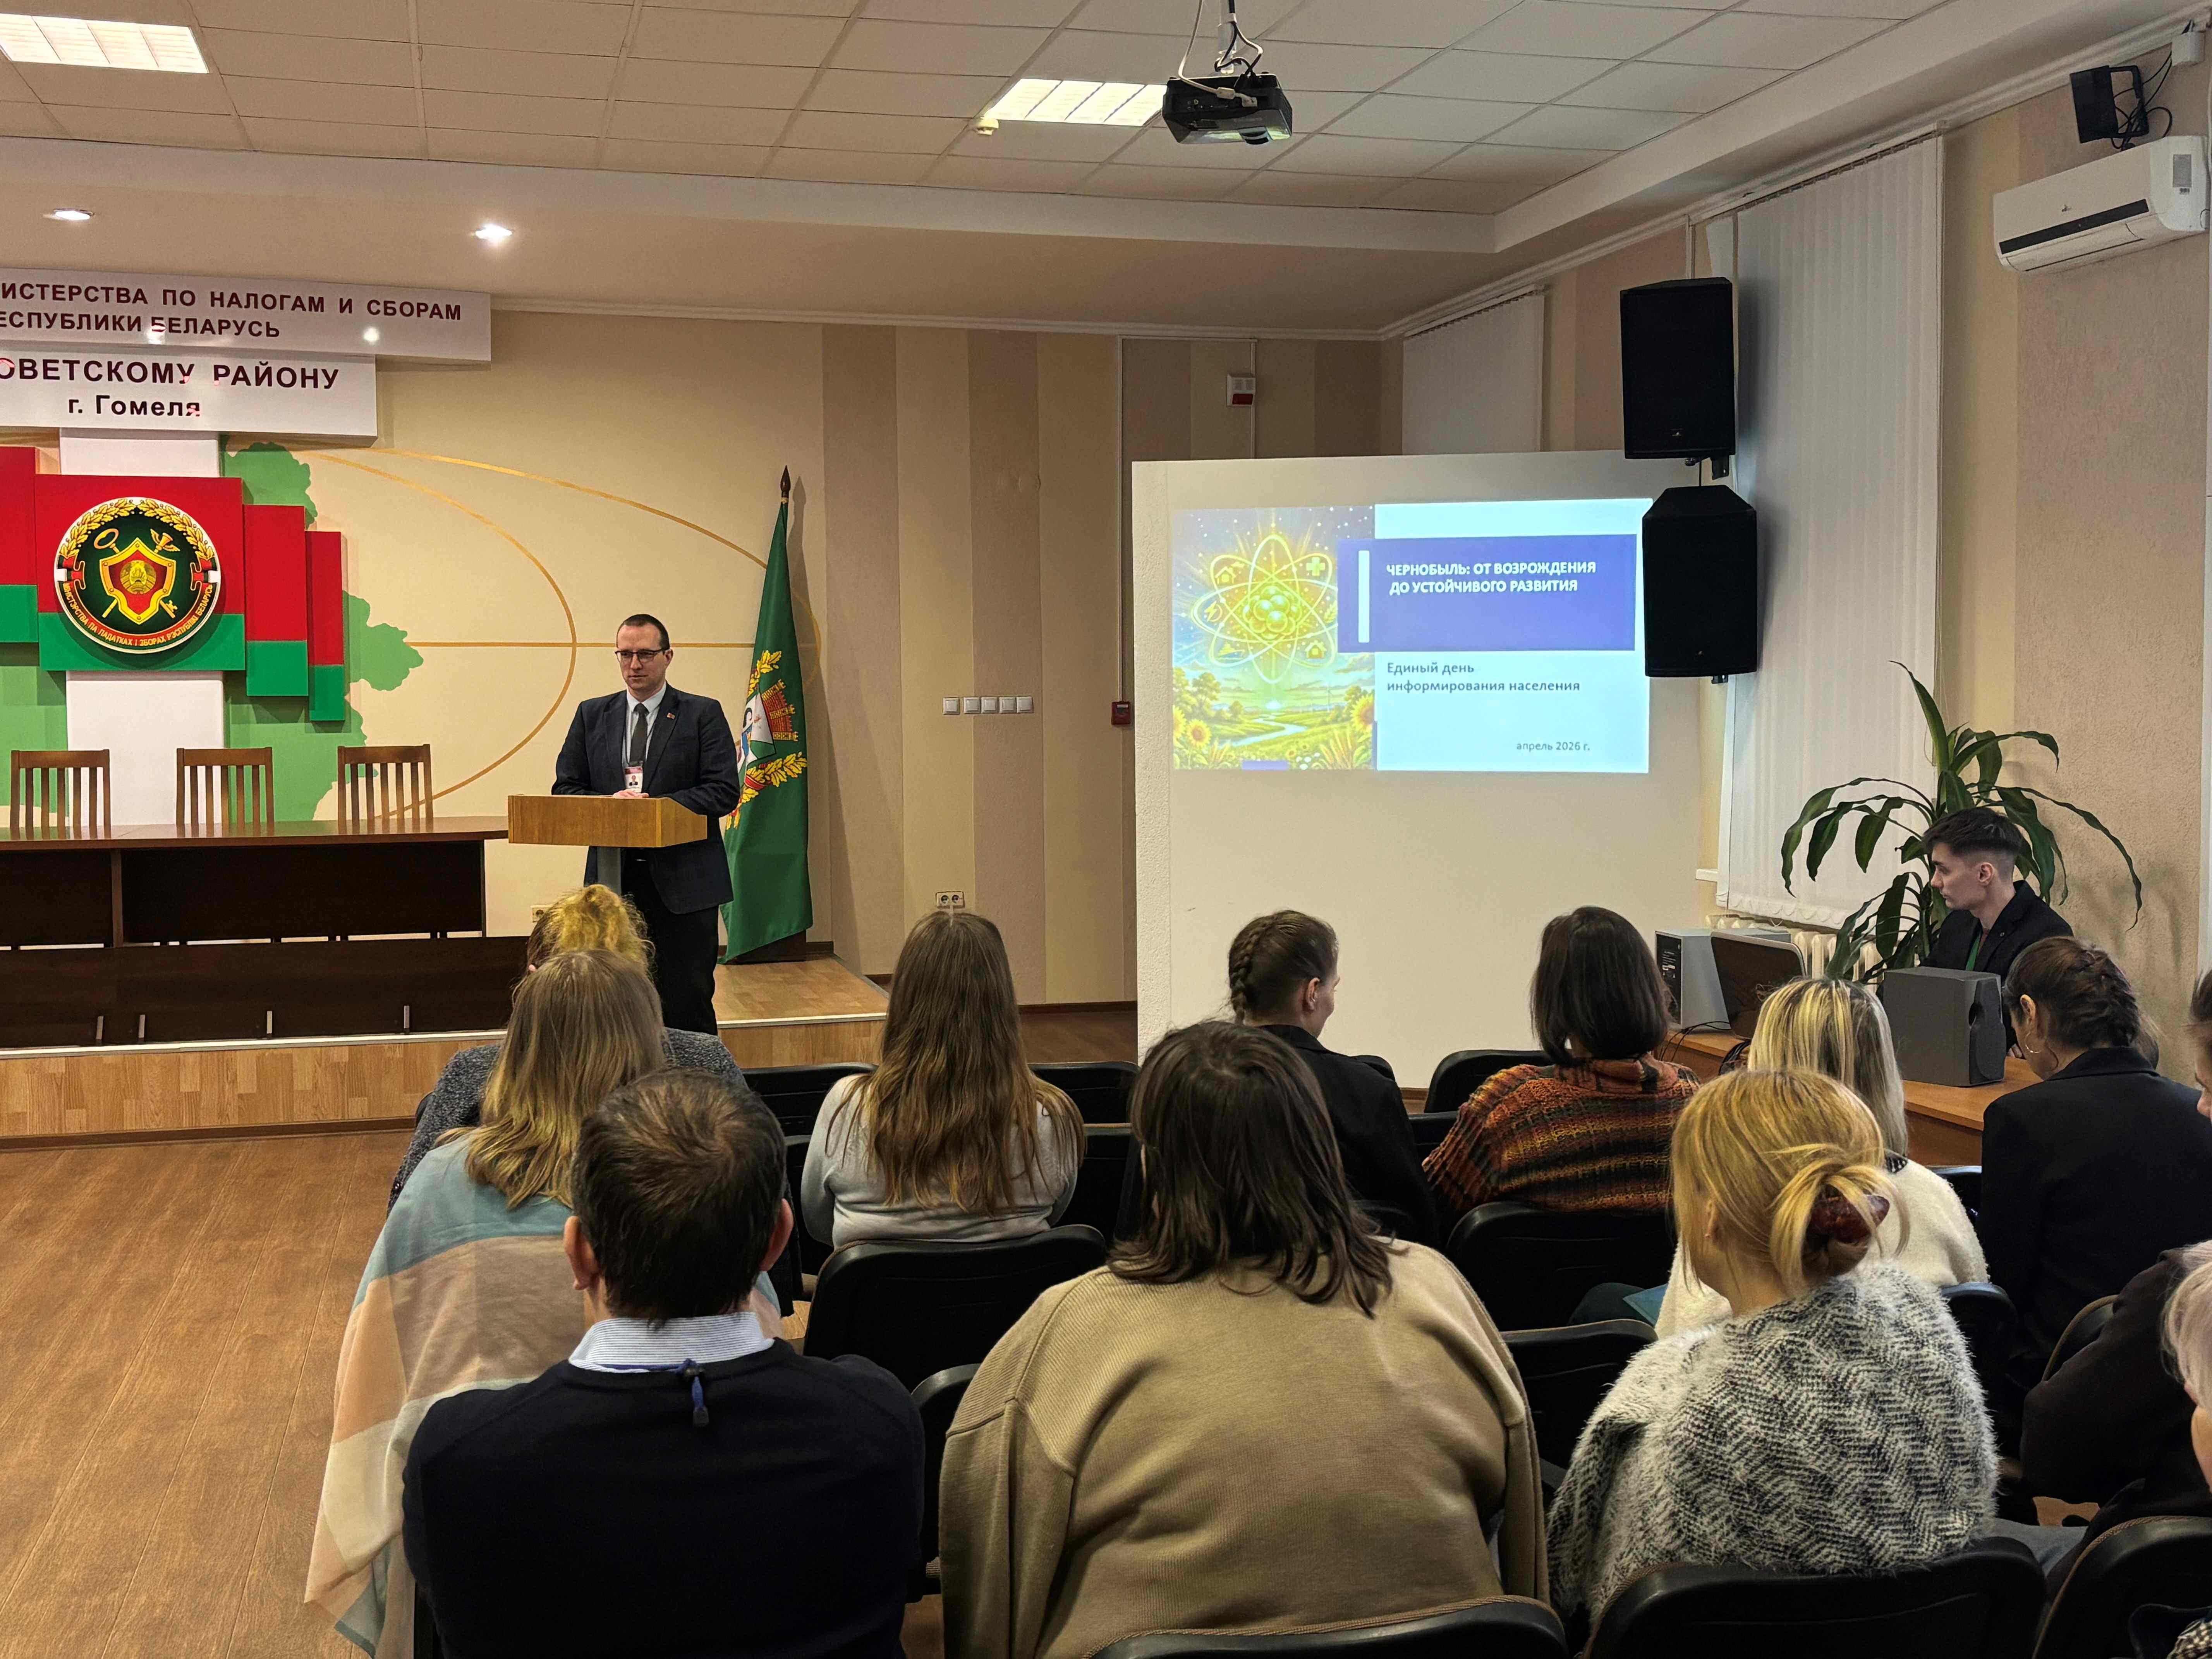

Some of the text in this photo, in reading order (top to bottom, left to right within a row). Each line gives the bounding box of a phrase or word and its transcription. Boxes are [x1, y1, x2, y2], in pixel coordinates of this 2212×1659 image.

[163, 289, 196, 306] ПО
[210, 291, 325, 313] НАЛОГАМ
[339, 298, 352, 314] И
[367, 299, 461, 320] СБОРАМ
[151, 316, 280, 338] БЕЛАРУСЬ
[0, 357, 339, 389] ОВЕТСКОМУ РАЙОНУ
[69, 395, 200, 417] г. Гомеля
[1386, 562, 1596, 576] ЧЕРНОБЫЛЬ: ОТ ВОЗРОЖДЕНИЯ
[1389, 579, 1578, 596] ДО УСТОЙЧИВОГО РАЗВИТИЯ
[139, 635, 167, 646] ЗБОРАХ
[1388, 662, 1474, 675] Единый день
[1387, 680, 1504, 693] информирования
[1516, 743, 1553, 752] апрель
[1556, 742, 1580, 750] 2026
